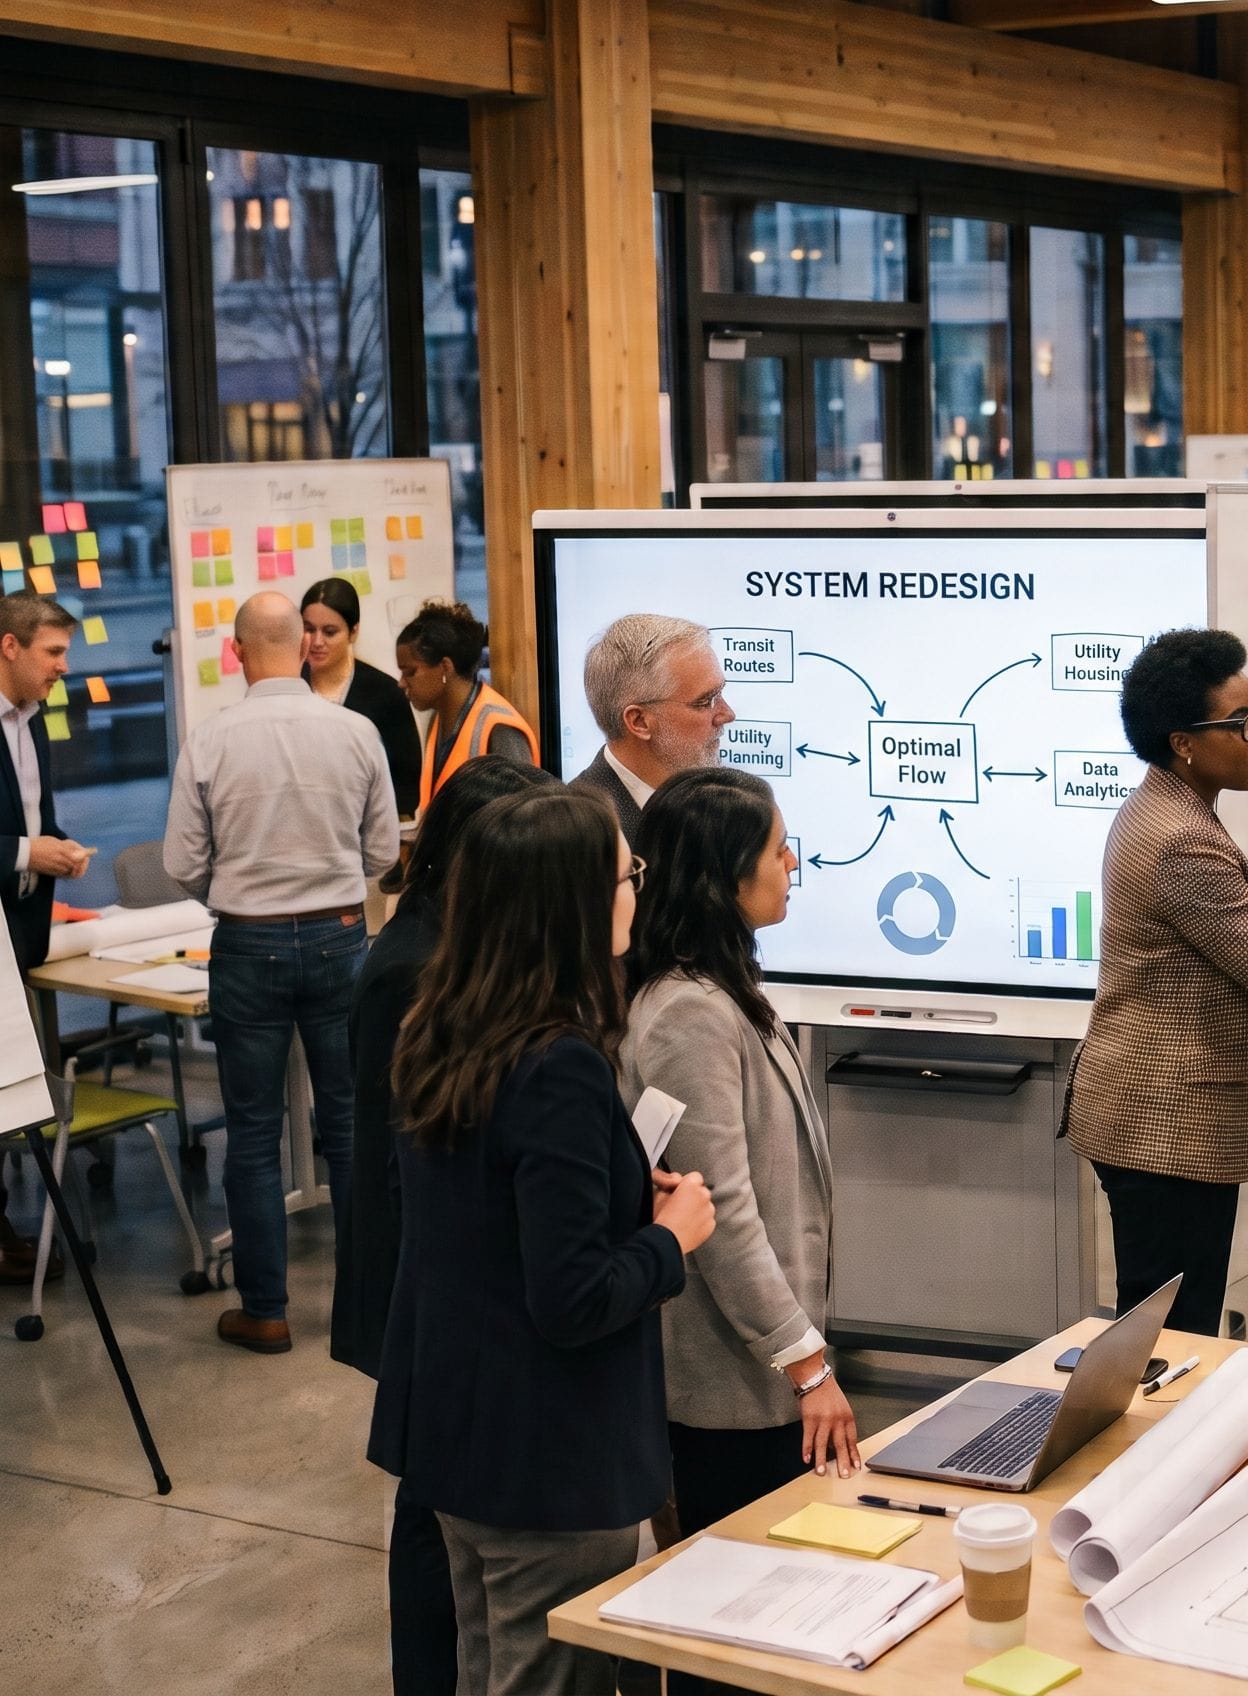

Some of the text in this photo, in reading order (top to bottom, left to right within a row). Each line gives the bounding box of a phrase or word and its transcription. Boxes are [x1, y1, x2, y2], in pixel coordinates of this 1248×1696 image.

[746, 571, 1035, 600] SYSTEM REDESIGN
[722, 637, 775, 653] Transit
[1075, 643, 1121, 663] Utility
[724, 658, 775, 673] Routes
[728, 729, 772, 748] Utility
[882, 736, 961, 758] Optimal
[719, 749, 784, 769] Planning
[1083, 761, 1118, 777] Data
[898, 764, 946, 785] Flow
